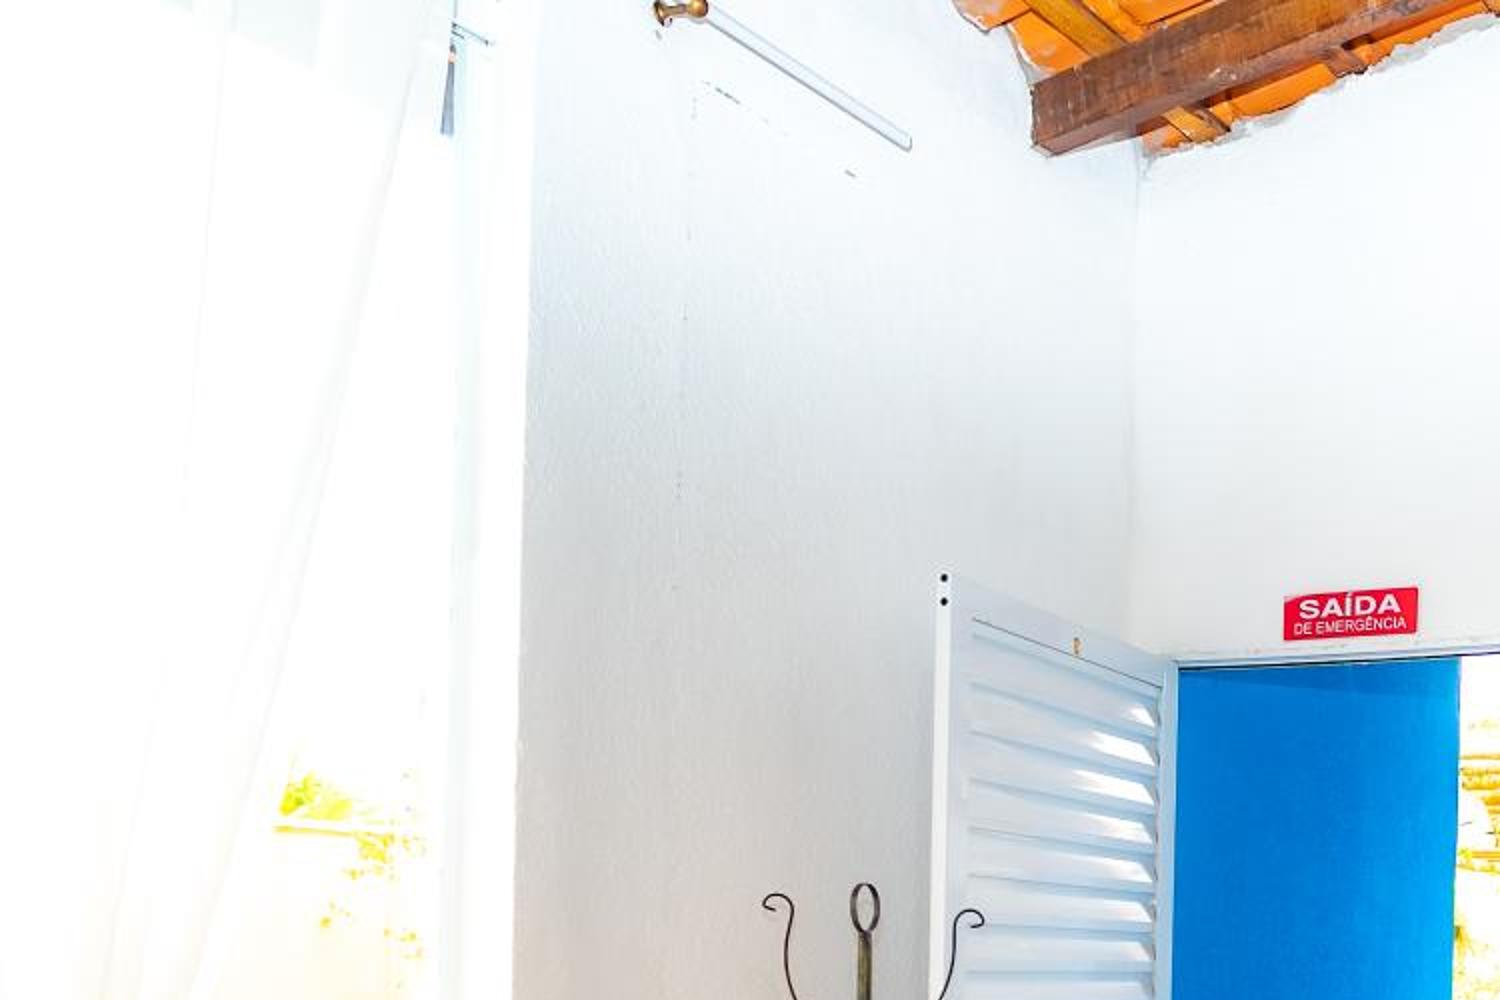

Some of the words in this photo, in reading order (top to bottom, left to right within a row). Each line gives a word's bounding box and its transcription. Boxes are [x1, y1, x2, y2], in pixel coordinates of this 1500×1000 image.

[1299, 592, 1401, 620] SAÍDA
[1294, 621, 1312, 635] DE
[1315, 616, 1407, 633] EMERGÊNCIA
